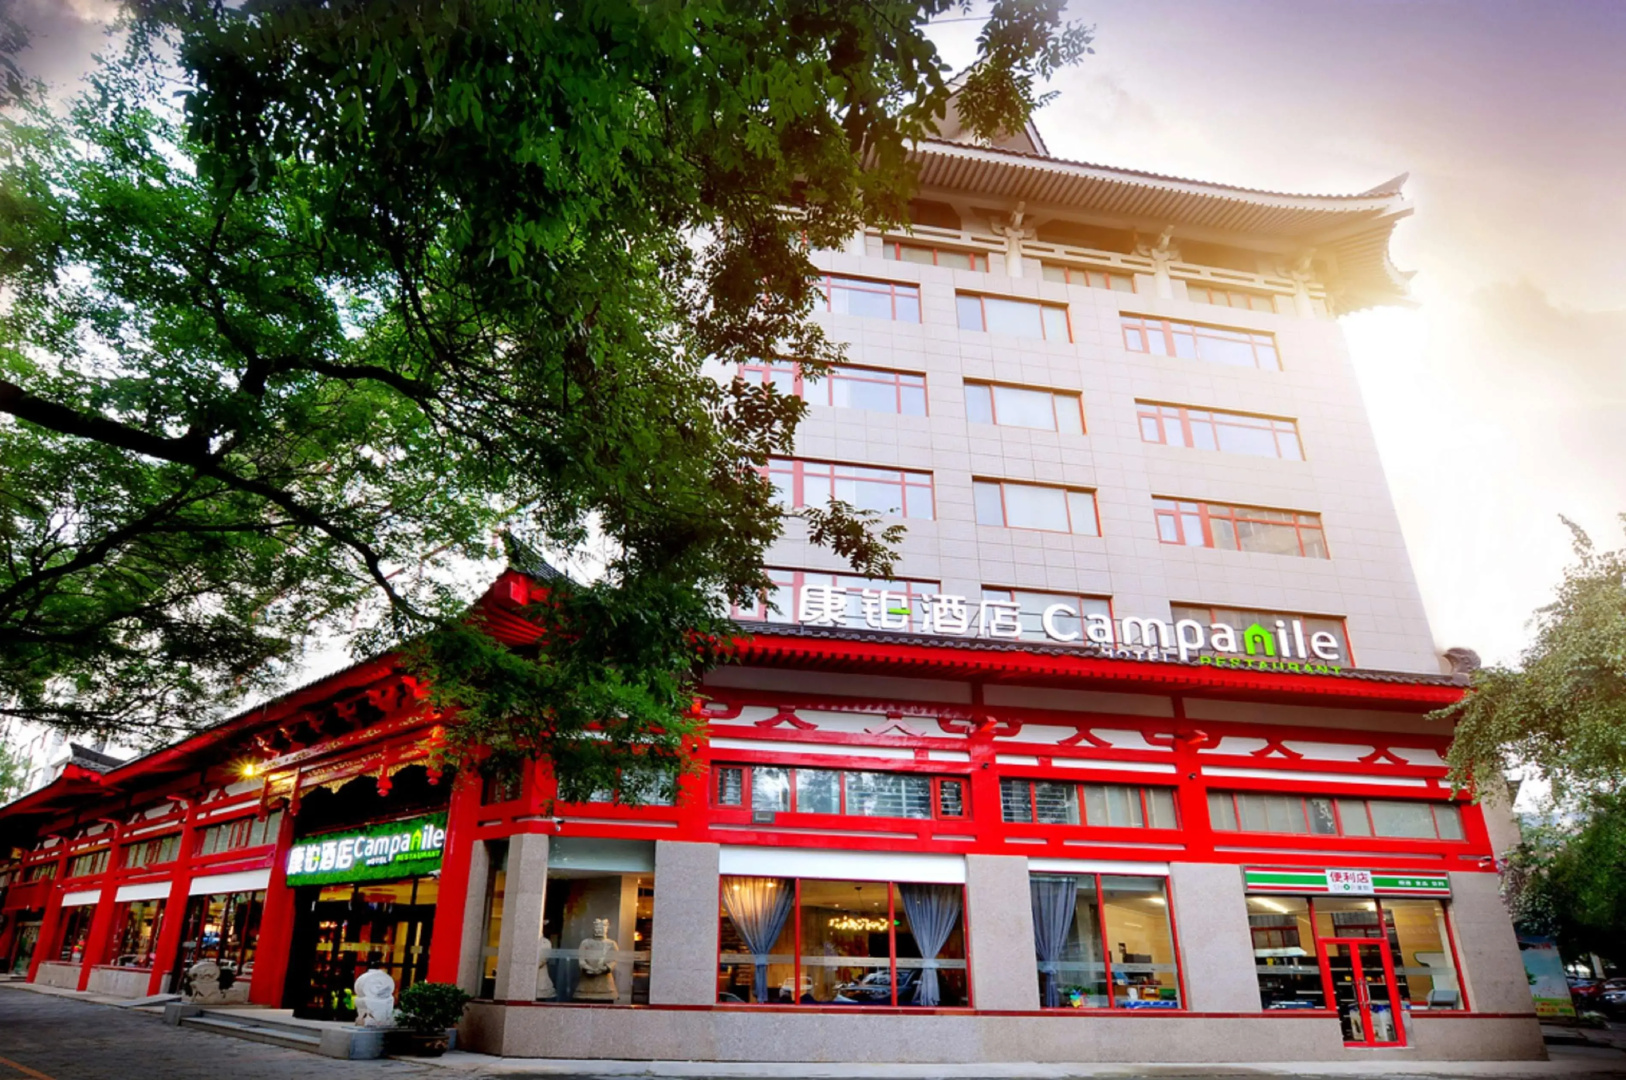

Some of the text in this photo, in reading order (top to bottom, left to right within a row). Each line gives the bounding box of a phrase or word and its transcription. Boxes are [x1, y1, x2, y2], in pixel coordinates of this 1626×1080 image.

[798, 584, 1340, 662] 康铂酒店 Campanile
[354, 824, 445, 861] Campanile
[1330, 871, 1369, 883] 便利店
